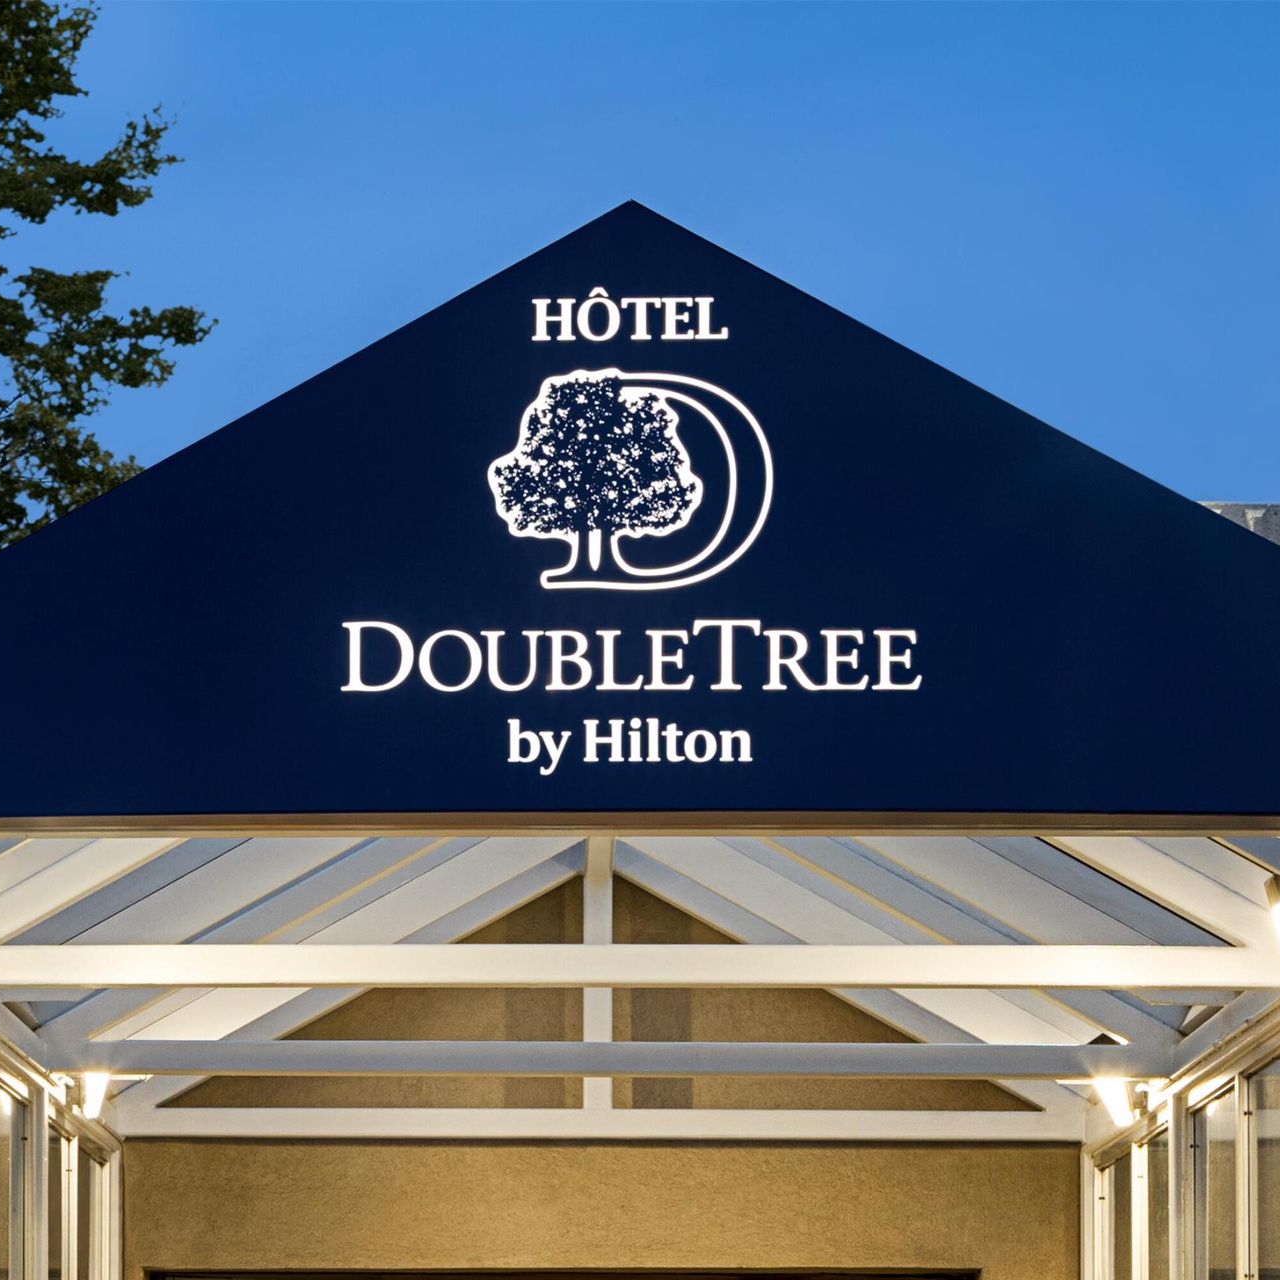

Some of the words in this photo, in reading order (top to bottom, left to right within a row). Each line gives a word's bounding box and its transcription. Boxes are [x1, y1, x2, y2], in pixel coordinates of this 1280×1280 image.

[531, 286, 729, 342] HÔTEL
[507, 718, 572, 776] by
[582, 717, 754, 763] Hilton
